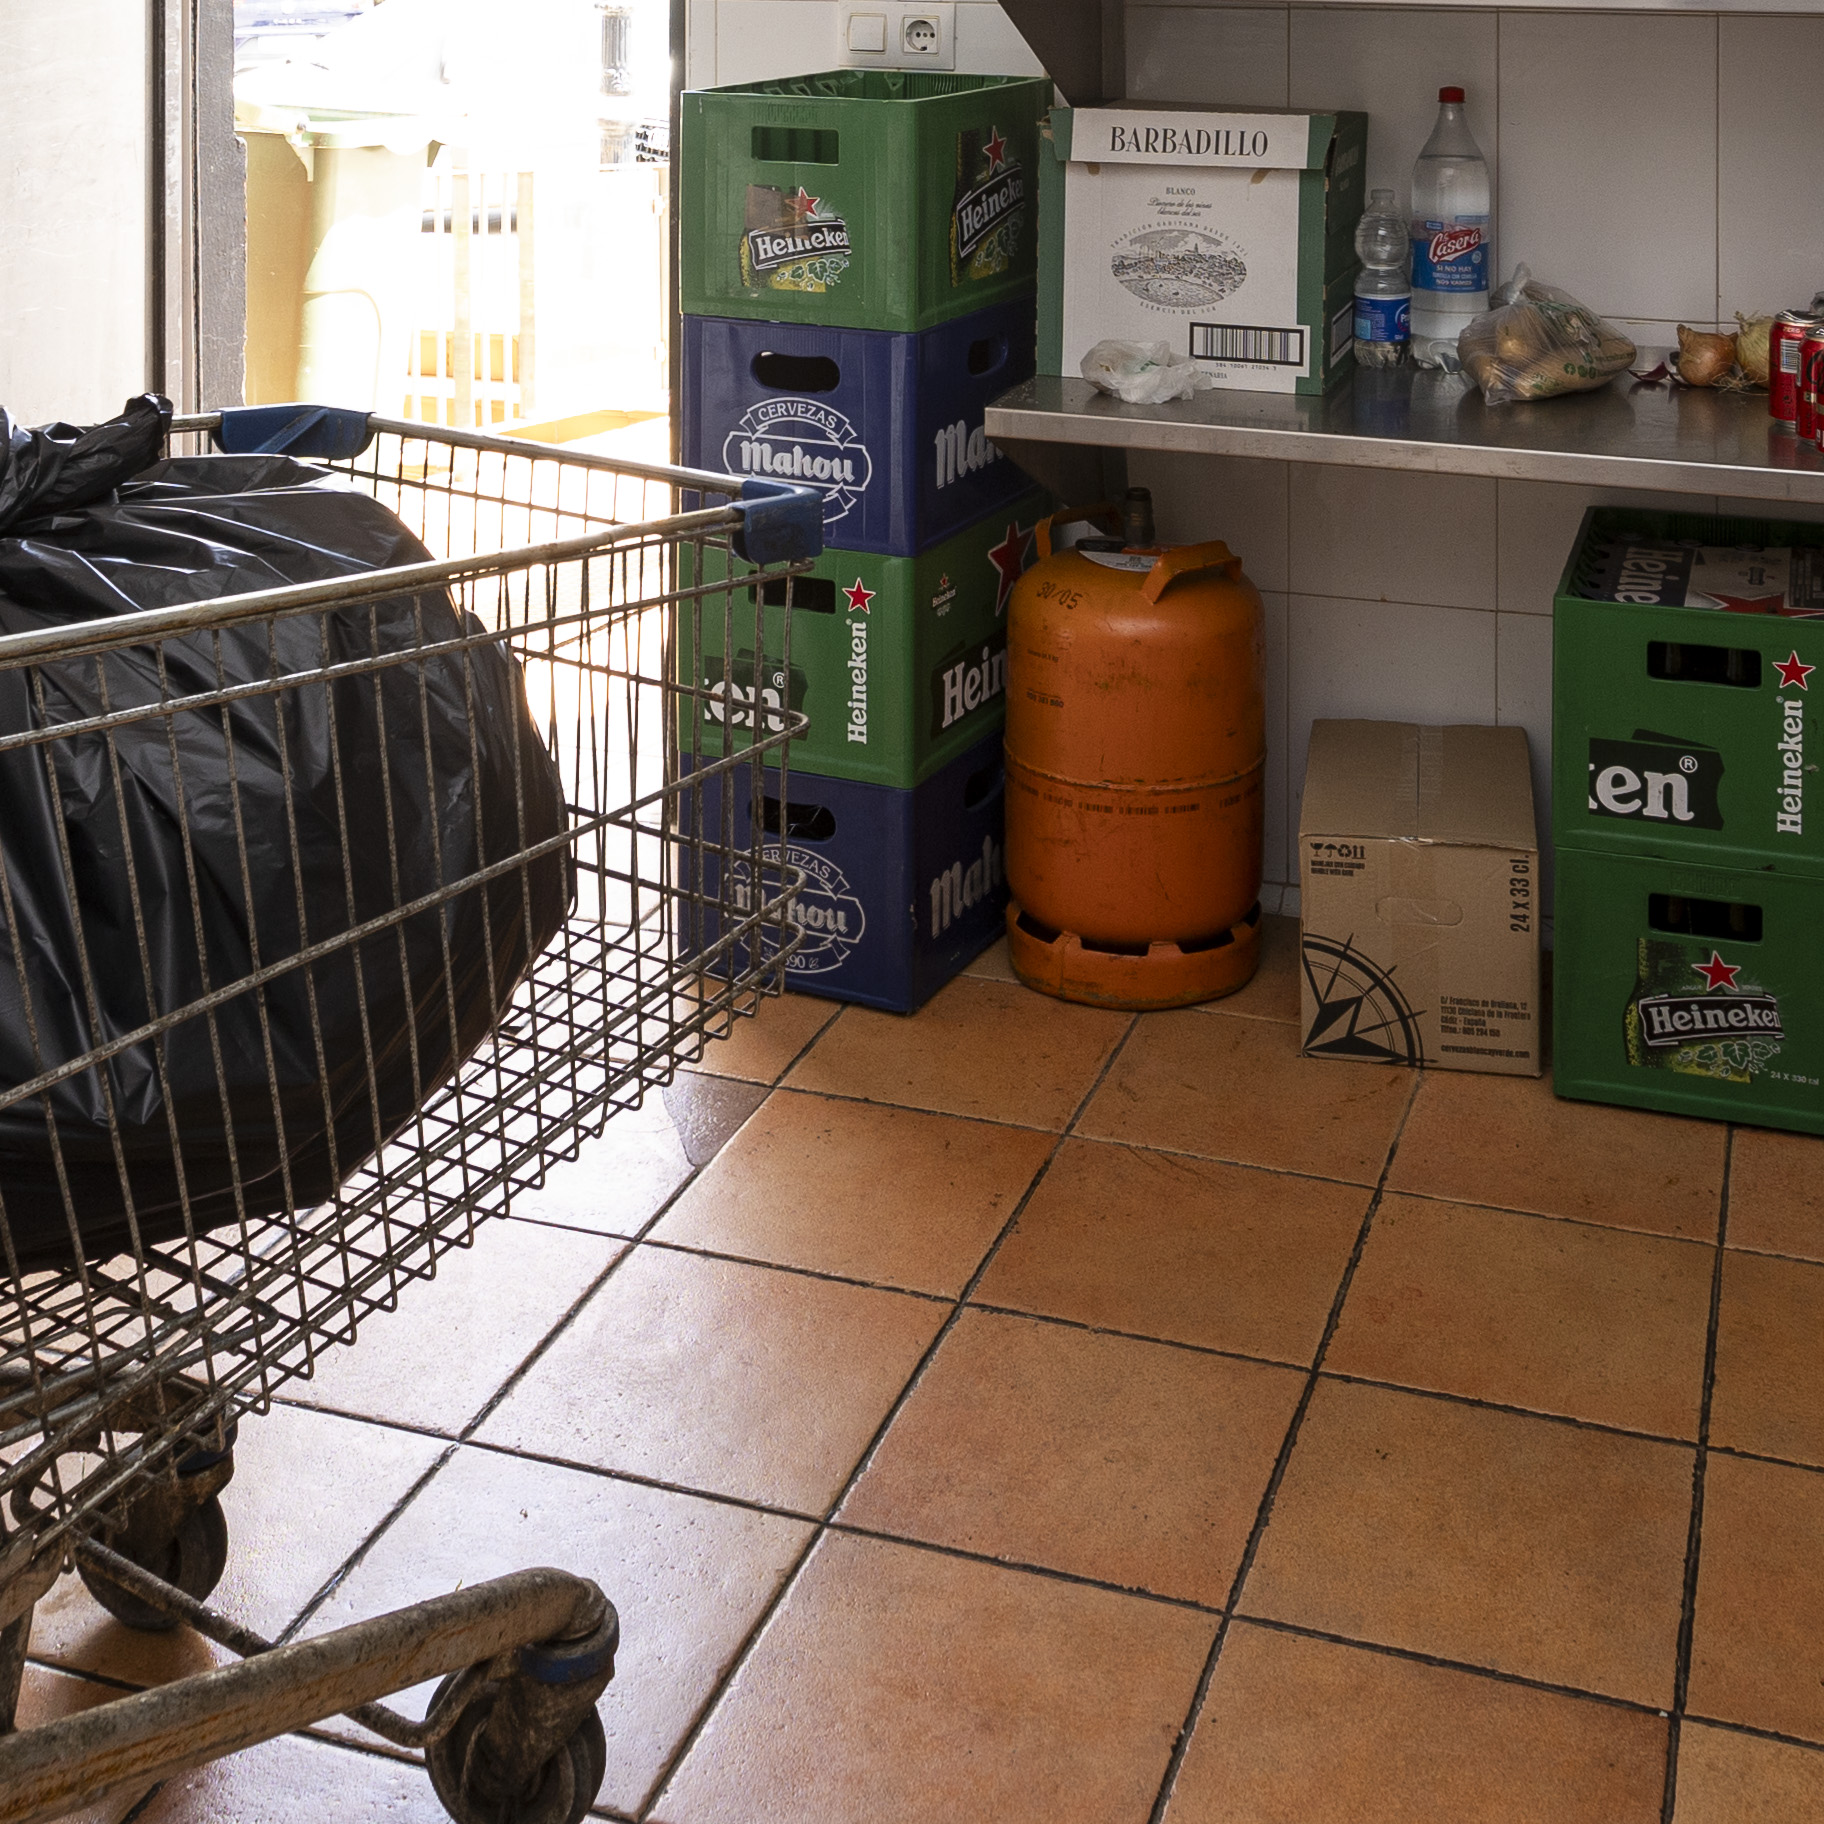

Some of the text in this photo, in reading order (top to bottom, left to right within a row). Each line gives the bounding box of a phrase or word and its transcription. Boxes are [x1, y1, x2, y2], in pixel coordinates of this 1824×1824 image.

[1109, 126, 1269, 157] BARBADILLO
[1166, 186, 1196, 196] BLANCO
[755, 227, 850, 261] Heineken
[1428, 227, 1481, 263] Casera
[1444, 265, 1457, 273] NO
[757, 401, 837, 429] CERVEZAS
[739, 439, 856, 483] Mahou
[1613, 545, 1684, 605] Heine
[1035, 580, 1084, 611] 30/05
[846, 621, 869, 746] Heineken
[1776, 698, 1804, 836] Heineken
[1509, 854, 1531, 933] 24 x 33 cl.
[1770, 1070, 1781, 1080] 24
[1790, 1073, 1807, 1084] 330
